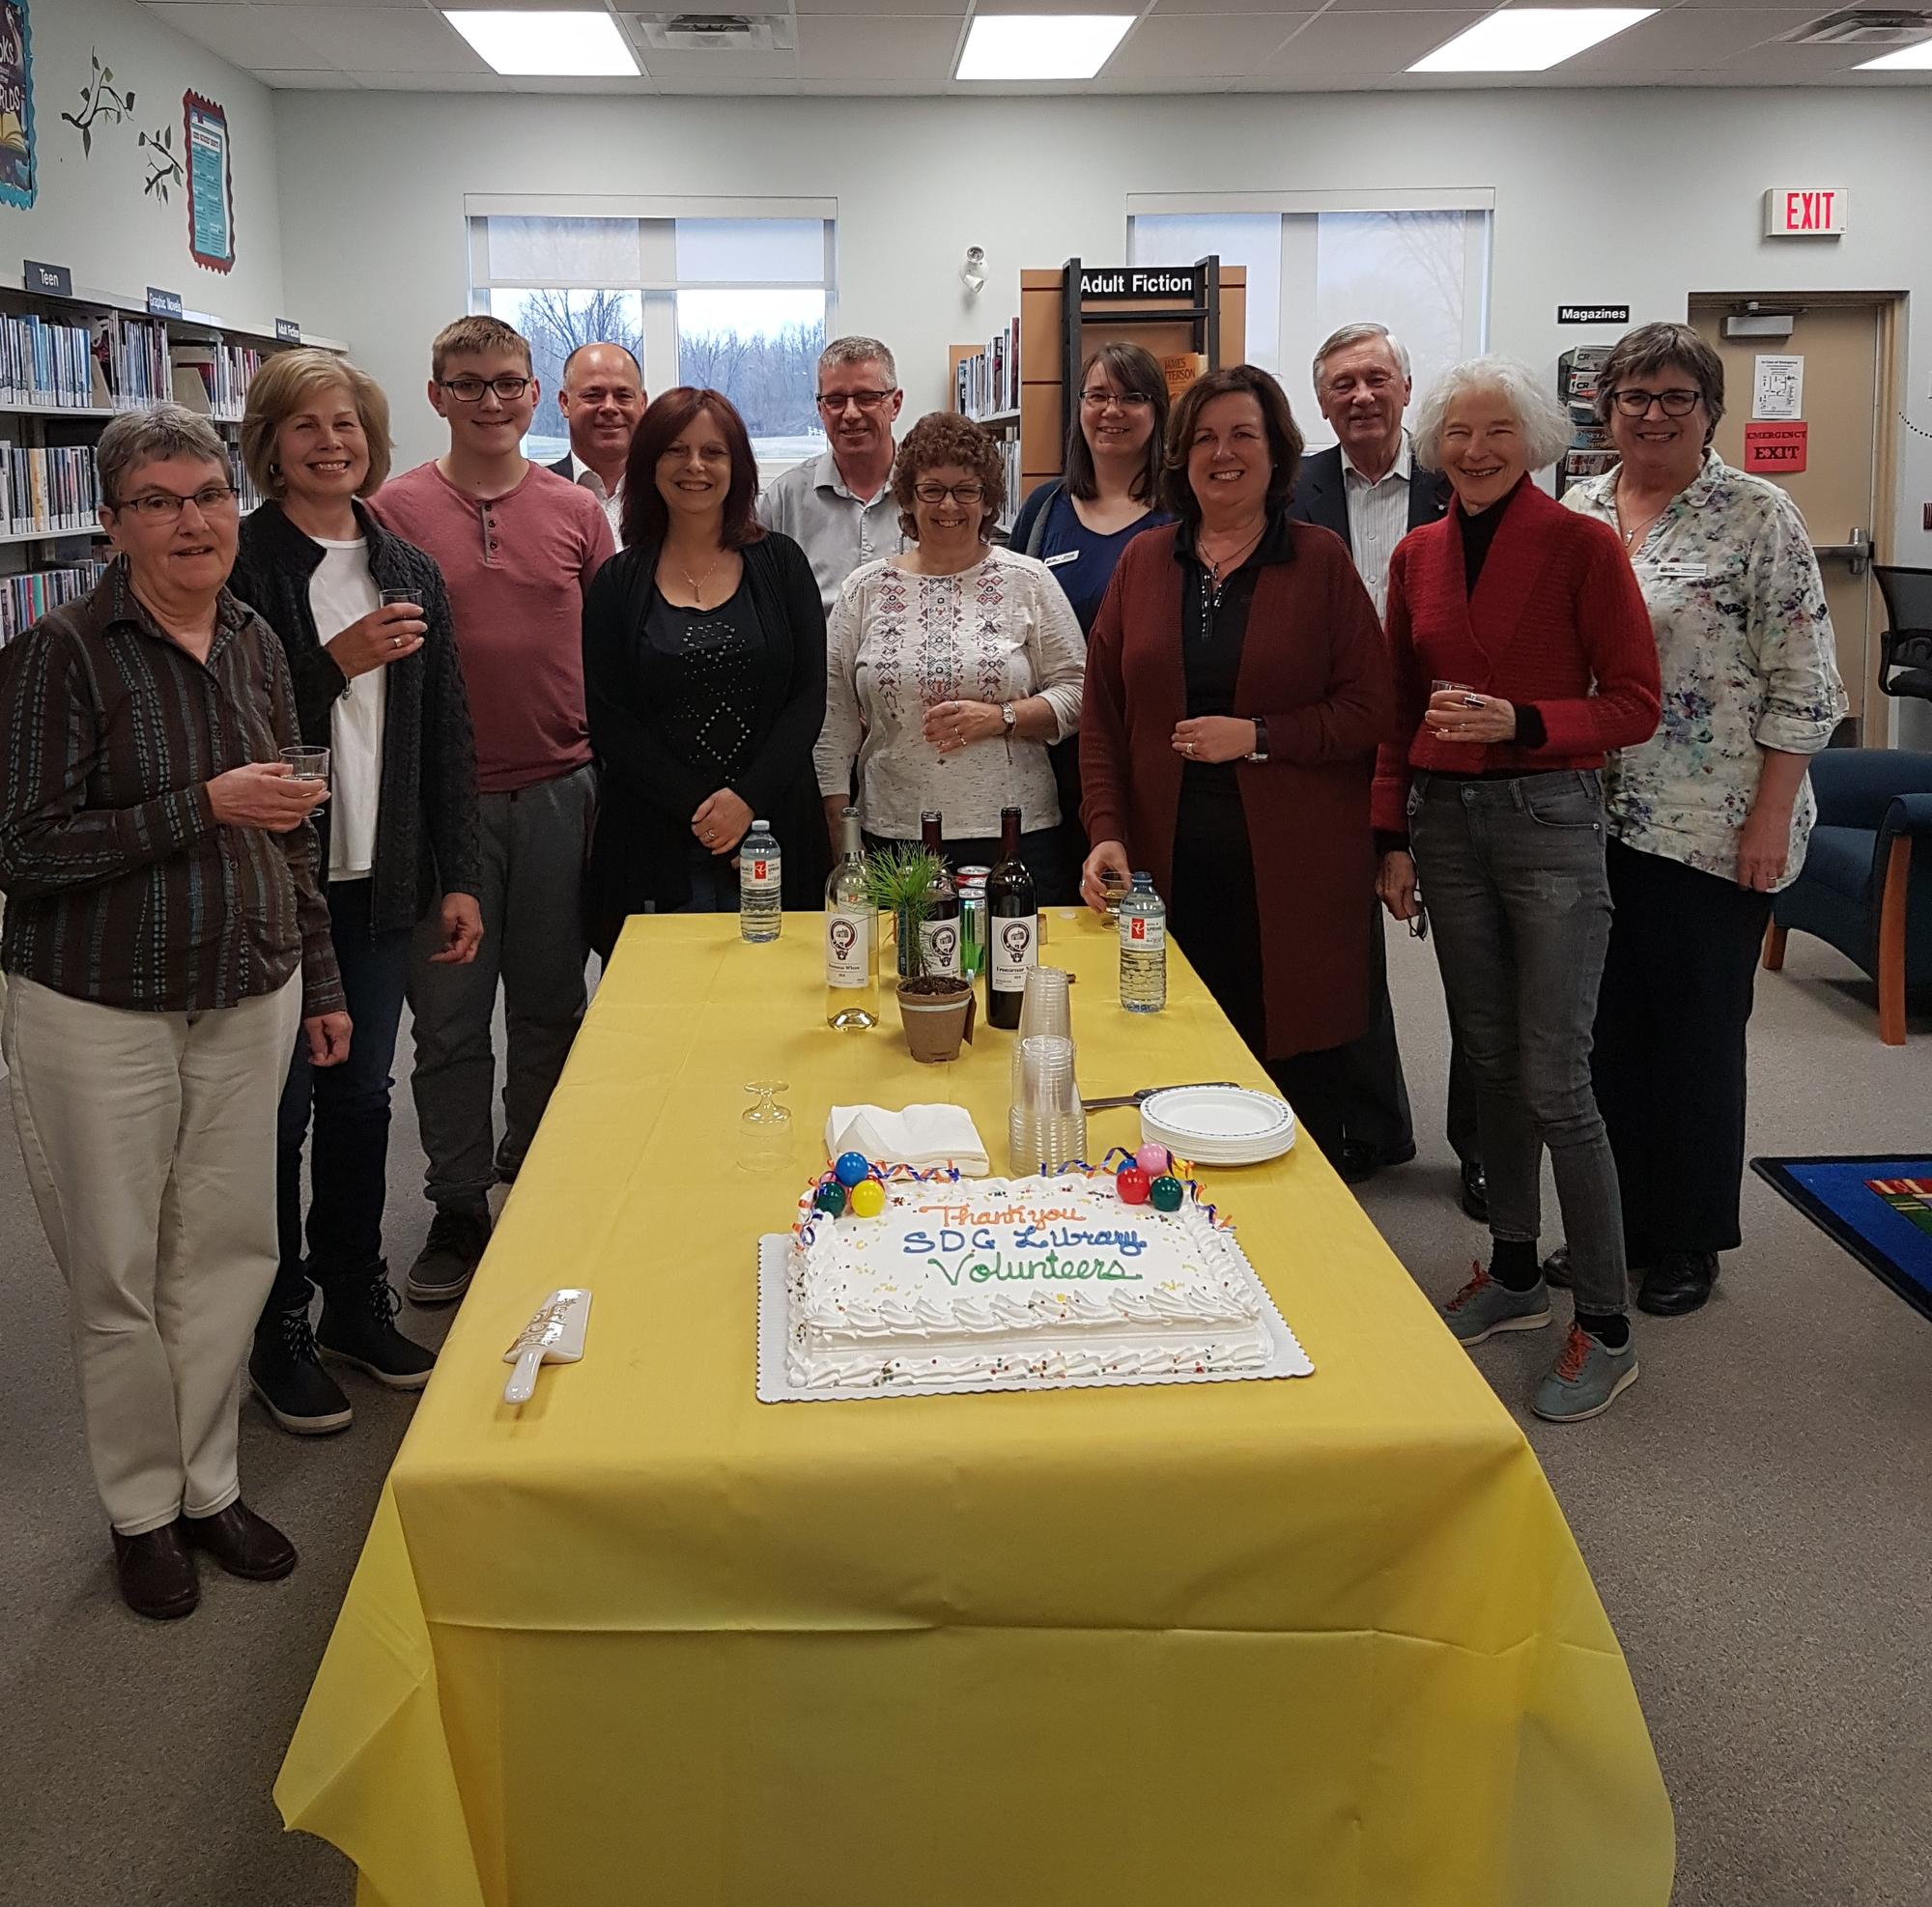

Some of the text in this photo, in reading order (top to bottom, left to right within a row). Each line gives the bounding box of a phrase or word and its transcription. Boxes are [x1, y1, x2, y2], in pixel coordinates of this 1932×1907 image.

[1787, 192, 1834, 229] EXIT
[39, 268, 59, 287] Teen
[1081, 273, 1192, 293] Adult Fiction
[150, 293, 182, 312] Graphic Novels
[1562, 308, 1627, 321] Magazines
[1747, 430, 1806, 440] EMERGENCY
[1753, 445, 1800, 460] EXIT
[919, 1204, 1087, 1231] Thank you
[1014, 1225, 1147, 1257] Library
[927, 1249, 1143, 1286] Volunteers
